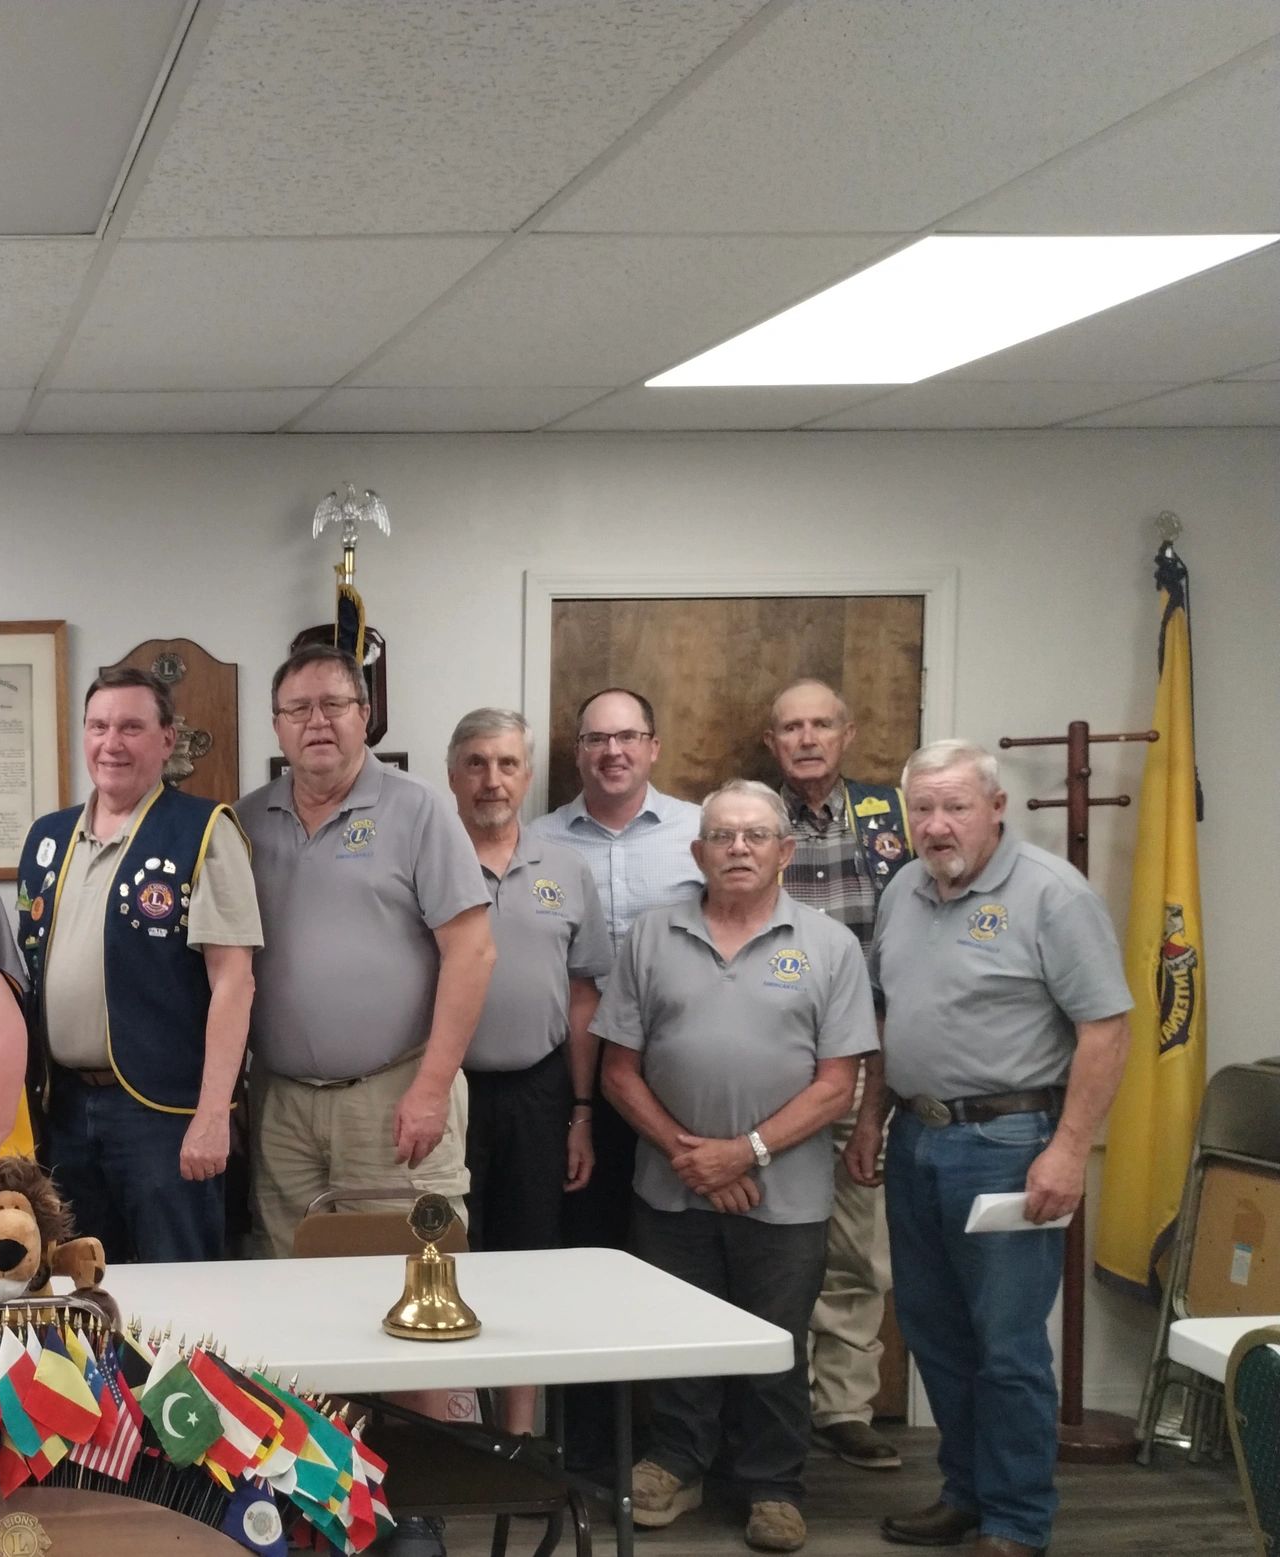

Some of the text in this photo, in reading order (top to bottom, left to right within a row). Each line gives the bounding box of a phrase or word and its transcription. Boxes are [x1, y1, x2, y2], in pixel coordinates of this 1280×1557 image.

[424, 1207, 439, 1228] L
[3, 1515, 36, 1529] LIONS
[11, 1532, 30, 1555] L
